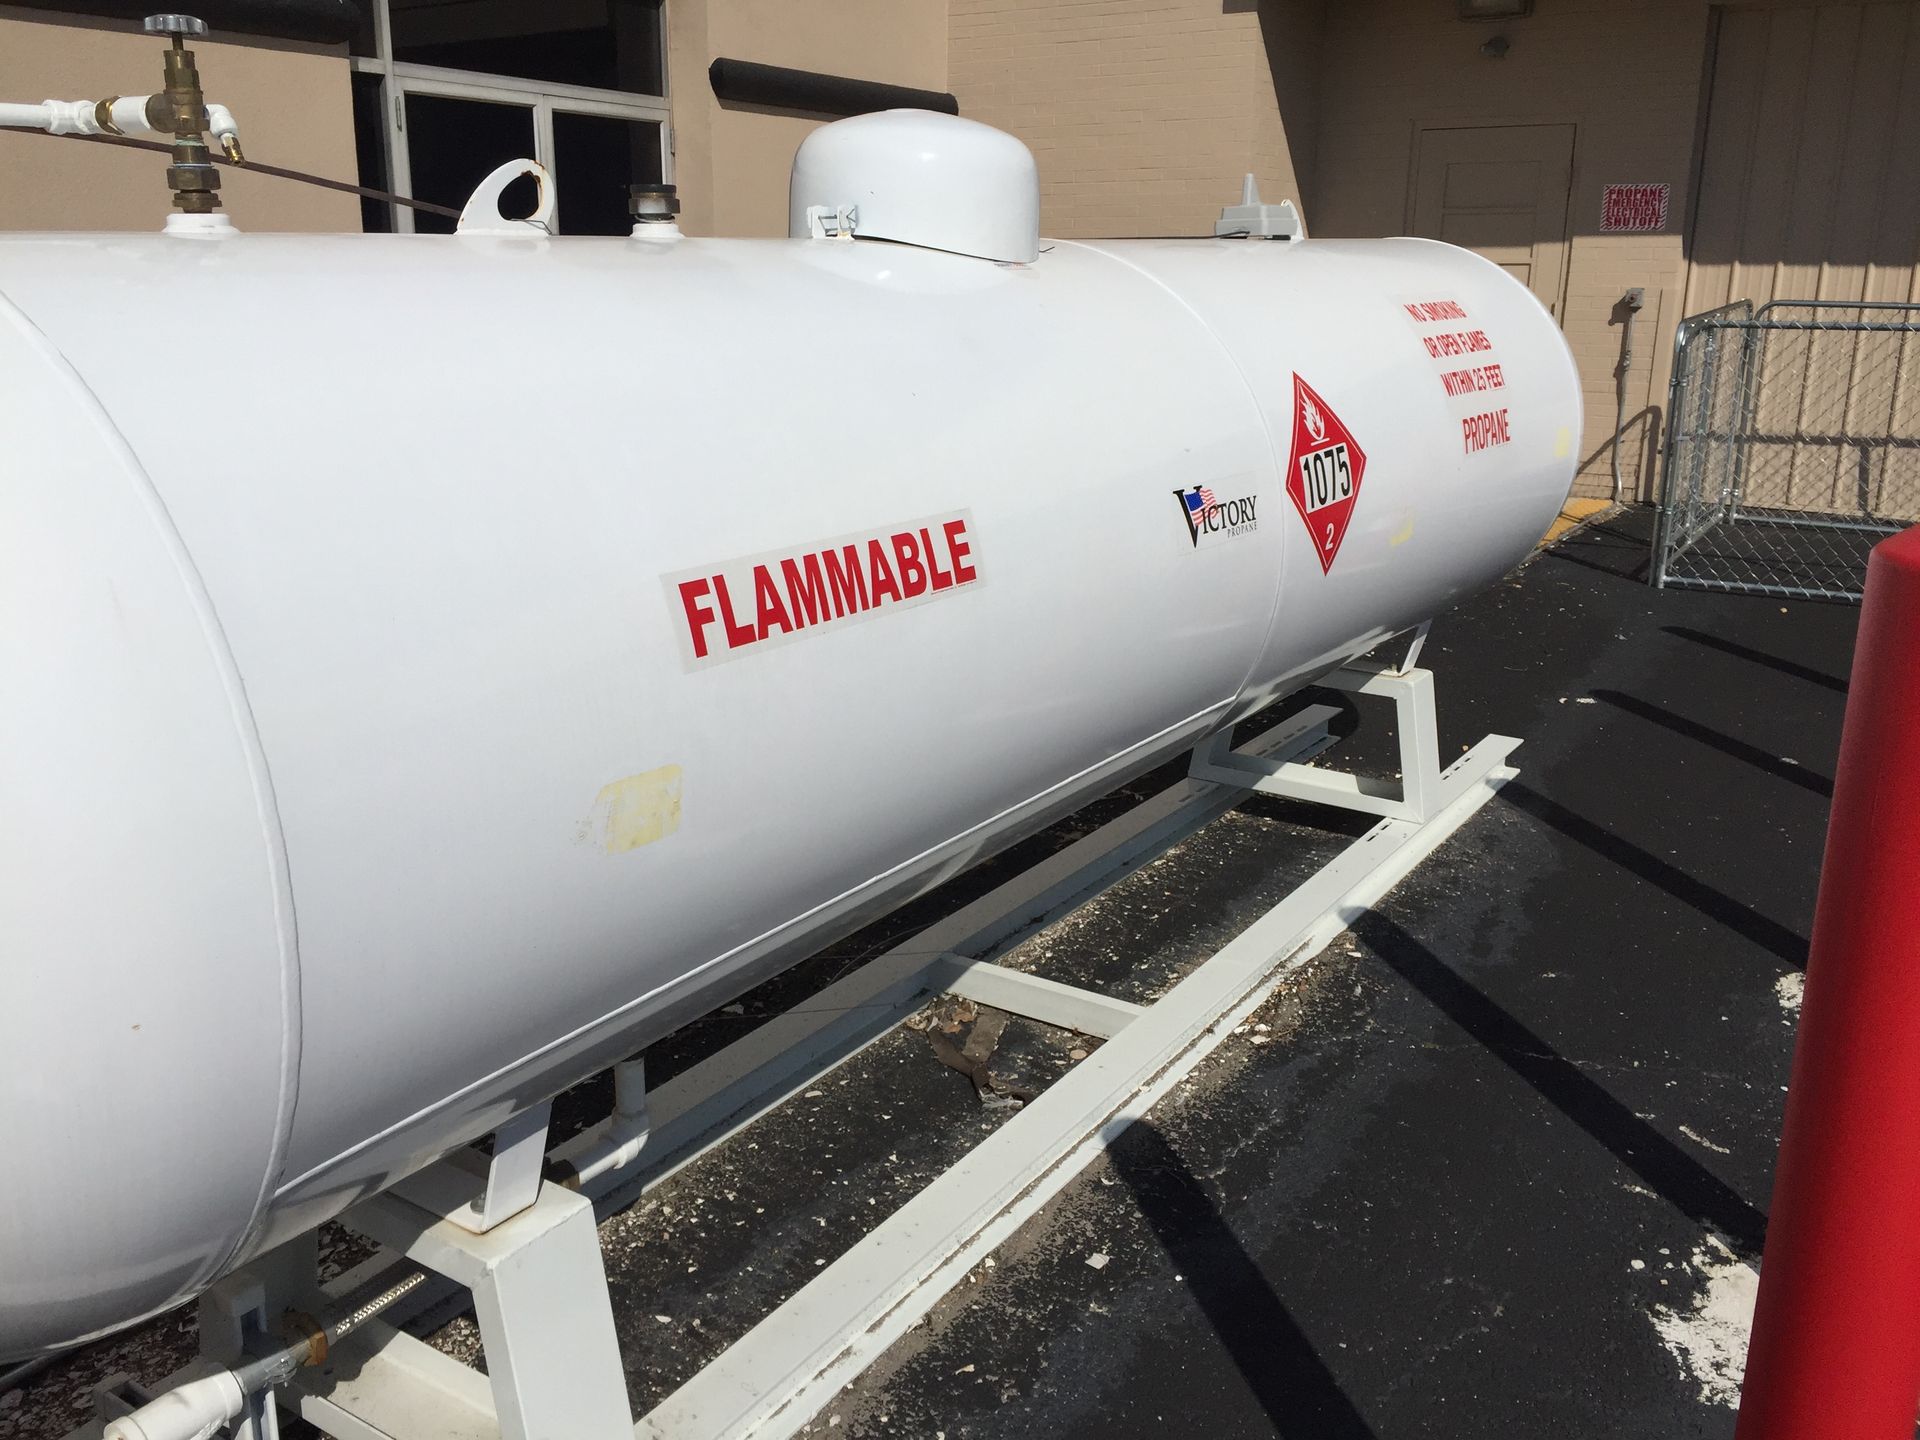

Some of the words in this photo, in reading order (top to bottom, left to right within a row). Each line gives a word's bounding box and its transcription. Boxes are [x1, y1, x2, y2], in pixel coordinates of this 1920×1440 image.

[1607, 198, 1663, 208] EMERGENCY
[1608, 188, 1665, 198] PROPANE
[1605, 216, 1661, 226] SHUTOFF
[1606, 207, 1661, 217] ELECTRICAL
[1403, 303, 1427, 322] NO
[1420, 300, 1467, 321] SMOKING
[1423, 337, 1442, 358] OR
[1436, 333, 1463, 357] OPEN
[1457, 330, 1492, 353] FLAMES
[1440, 369, 1476, 397] WITHIN
[1472, 367, 1487, 391] 25
[1483, 364, 1505, 389] FEET
[1462, 408, 1511, 454] PROPANE
[1303, 445, 1350, 509] 1075
[1172, 485, 1257, 548] VICTORY
[1227, 521, 1257, 538] PROPANE
[1325, 522, 1335, 551] 2
[678, 519, 977, 658] FLAMMABLE
